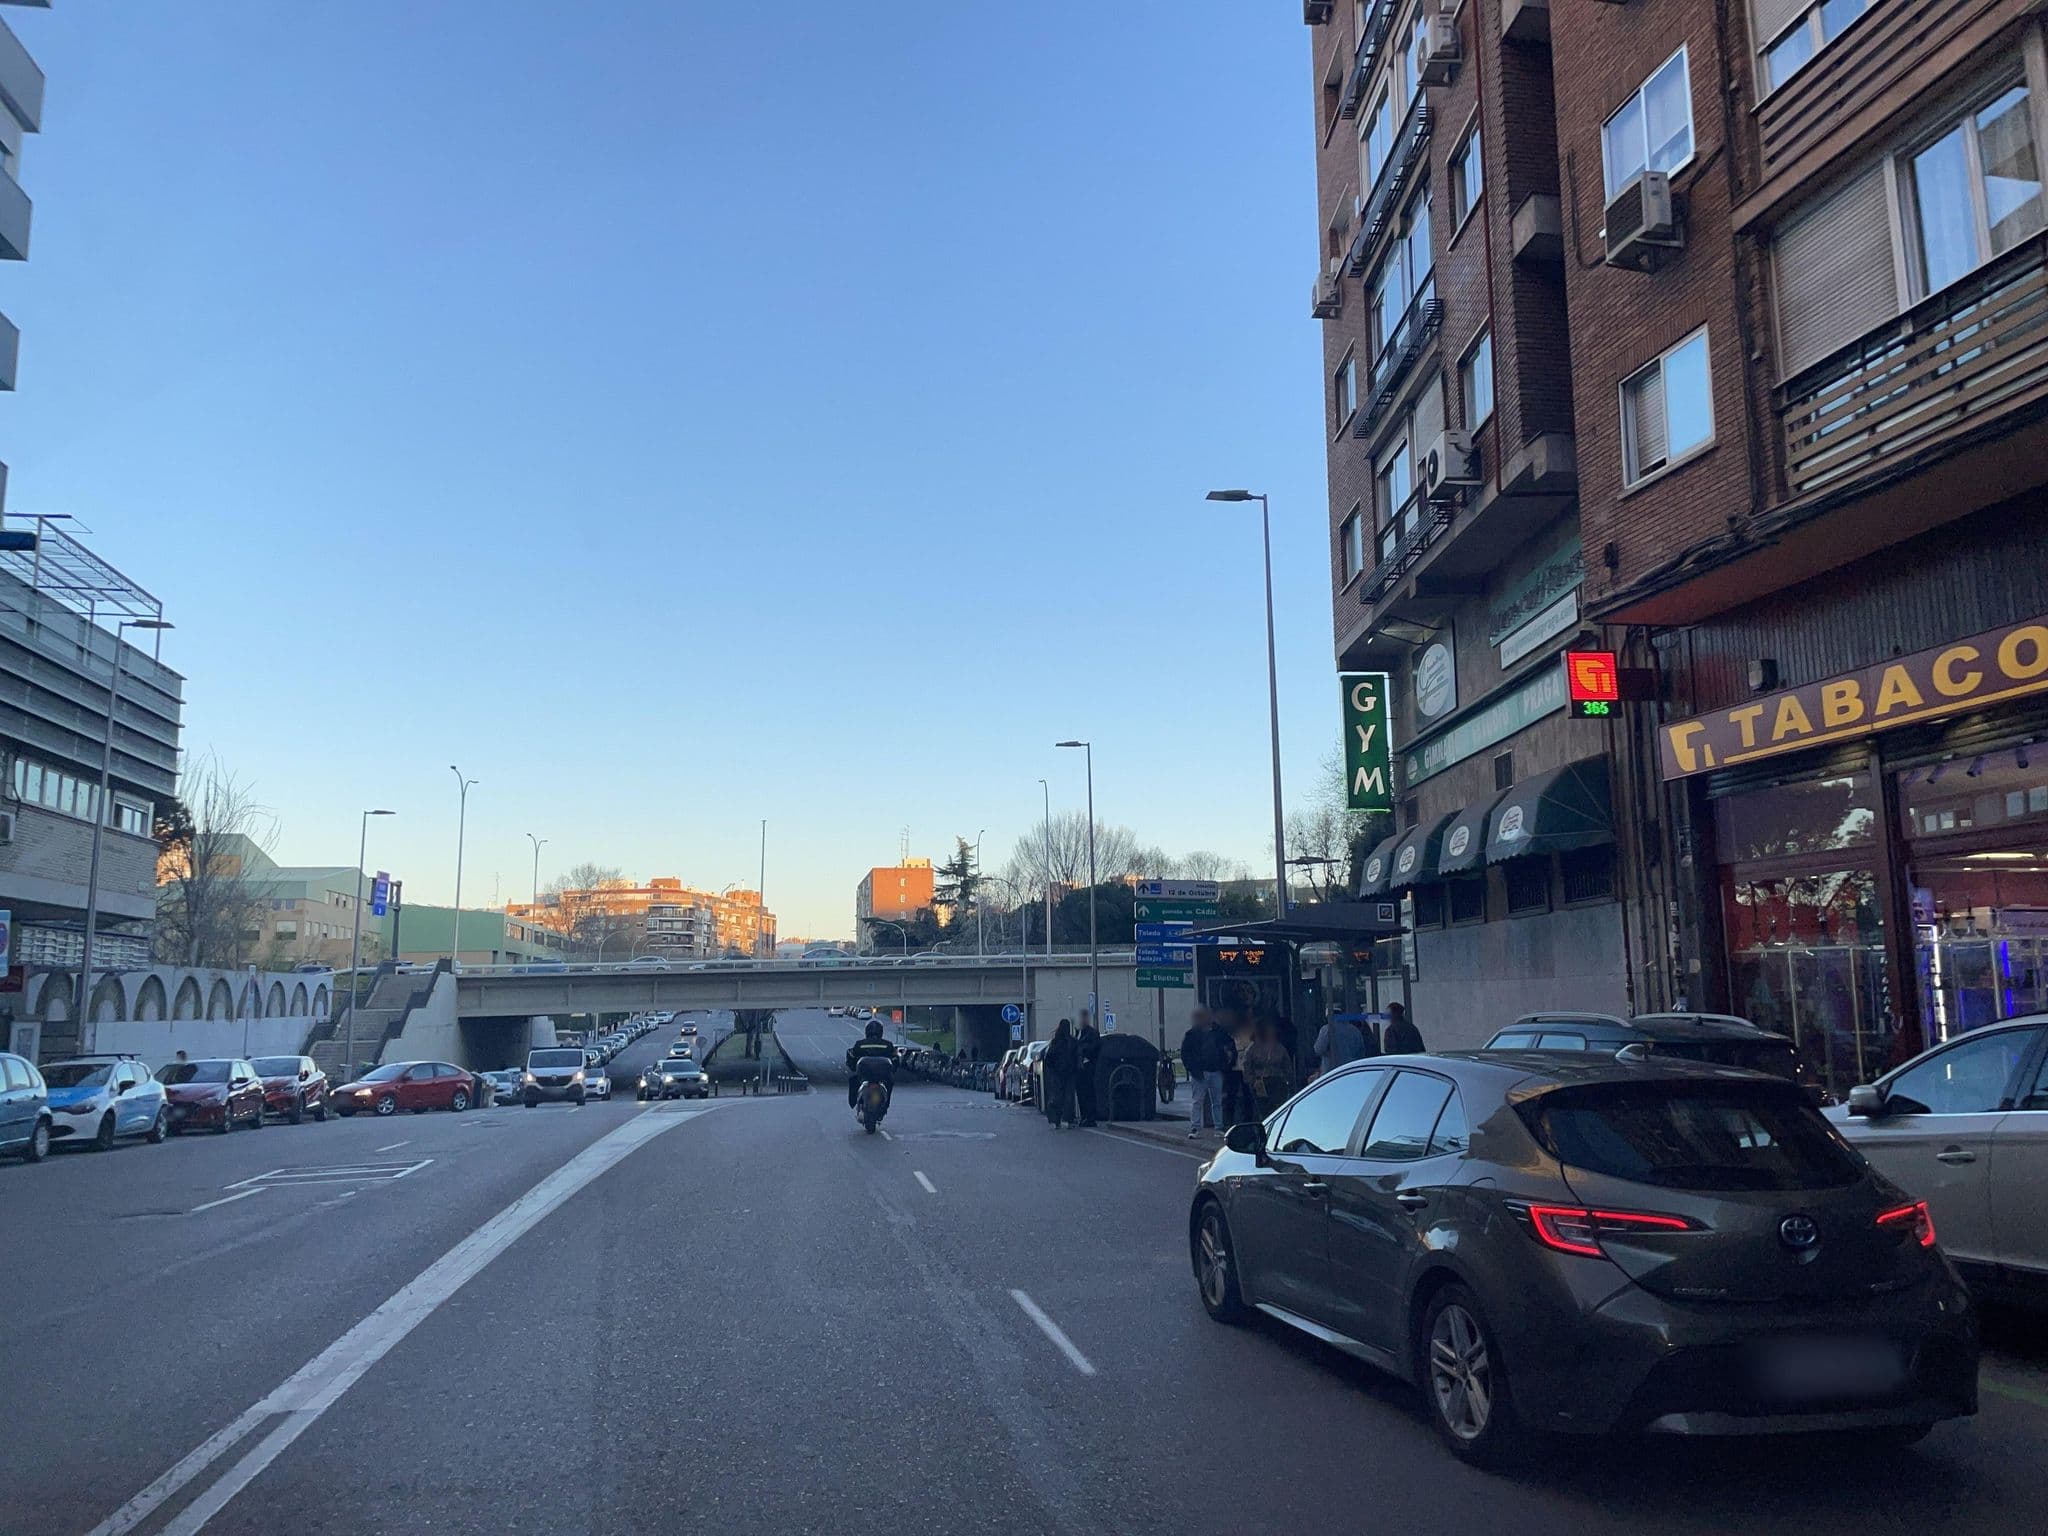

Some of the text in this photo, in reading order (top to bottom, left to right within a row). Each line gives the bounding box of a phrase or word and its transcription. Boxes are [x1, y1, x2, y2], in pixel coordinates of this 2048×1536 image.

[1351, 682, 1385, 796] GYM
[1583, 701, 1609, 714] 365
[1729, 626, 2048, 747] TABACO
